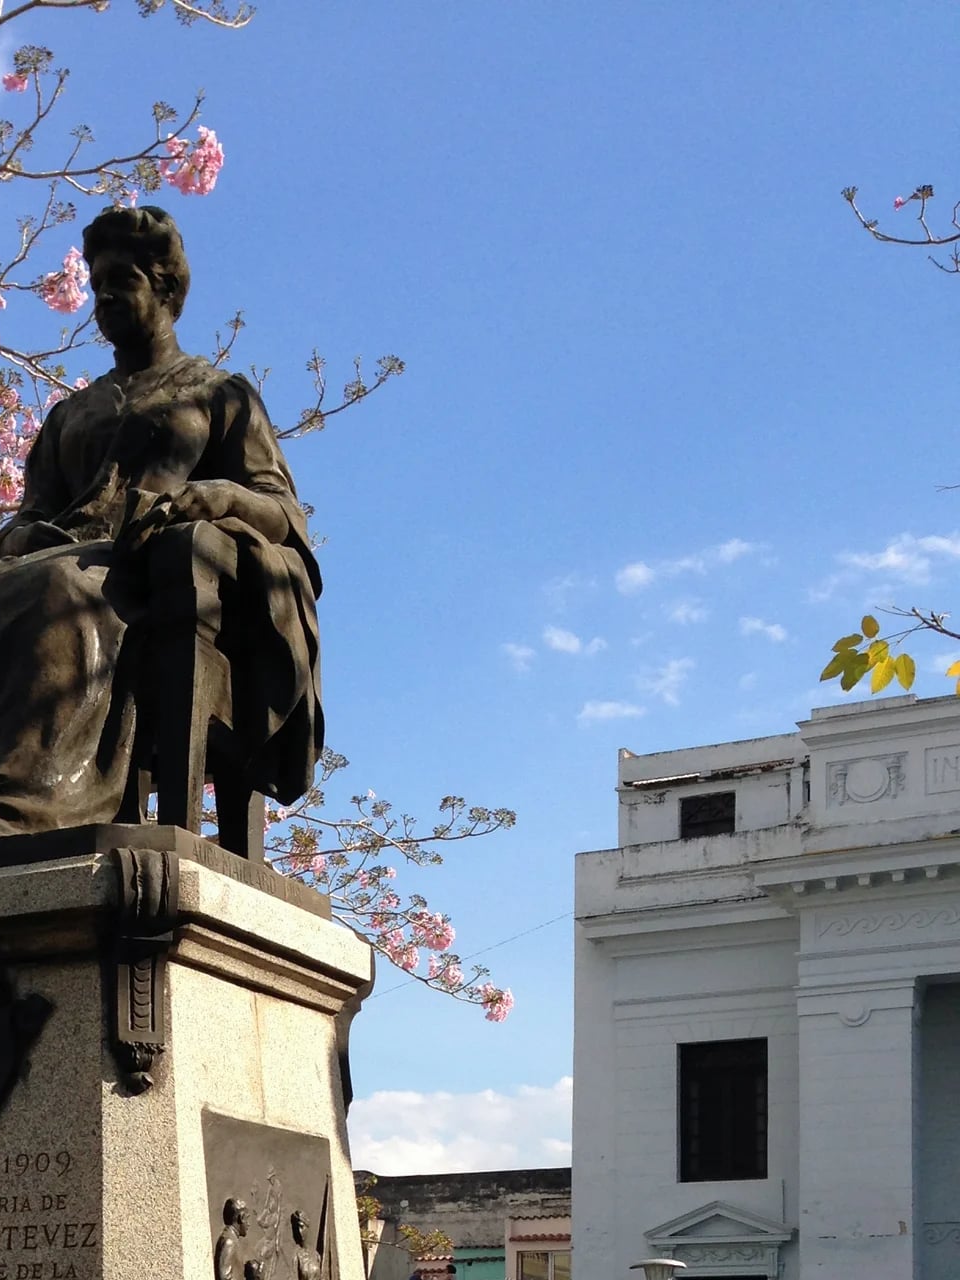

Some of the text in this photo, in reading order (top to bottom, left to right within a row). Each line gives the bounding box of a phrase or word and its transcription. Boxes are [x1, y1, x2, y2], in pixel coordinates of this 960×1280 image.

[3, 1150, 72, 1178] 1909
[40, 1193, 69, 1212] DE
[15, 1262, 43, 1280] DE
[51, 1260, 79, 1280] LA
